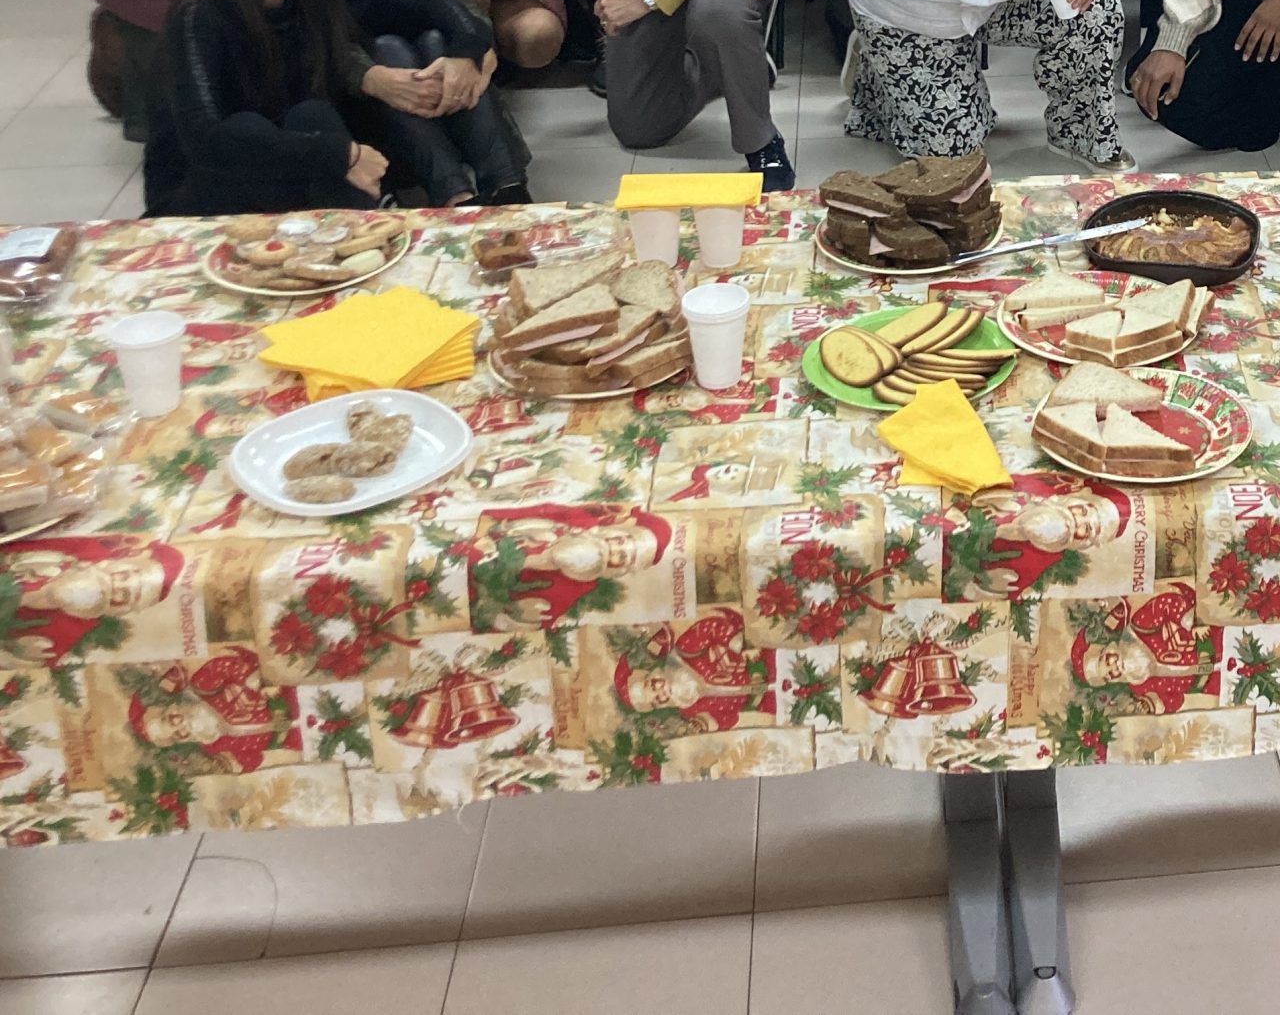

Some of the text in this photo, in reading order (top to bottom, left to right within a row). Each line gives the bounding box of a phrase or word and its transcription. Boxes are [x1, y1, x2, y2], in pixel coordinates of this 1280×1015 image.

[1132, 495, 1146, 527] MERRY
[1229, 479, 1266, 522] NOEL
[781, 506, 815, 545] NOEL
[1133, 529, 1148, 593] CHRISTMAS
[672, 558, 688, 619] CHRISTMAS
